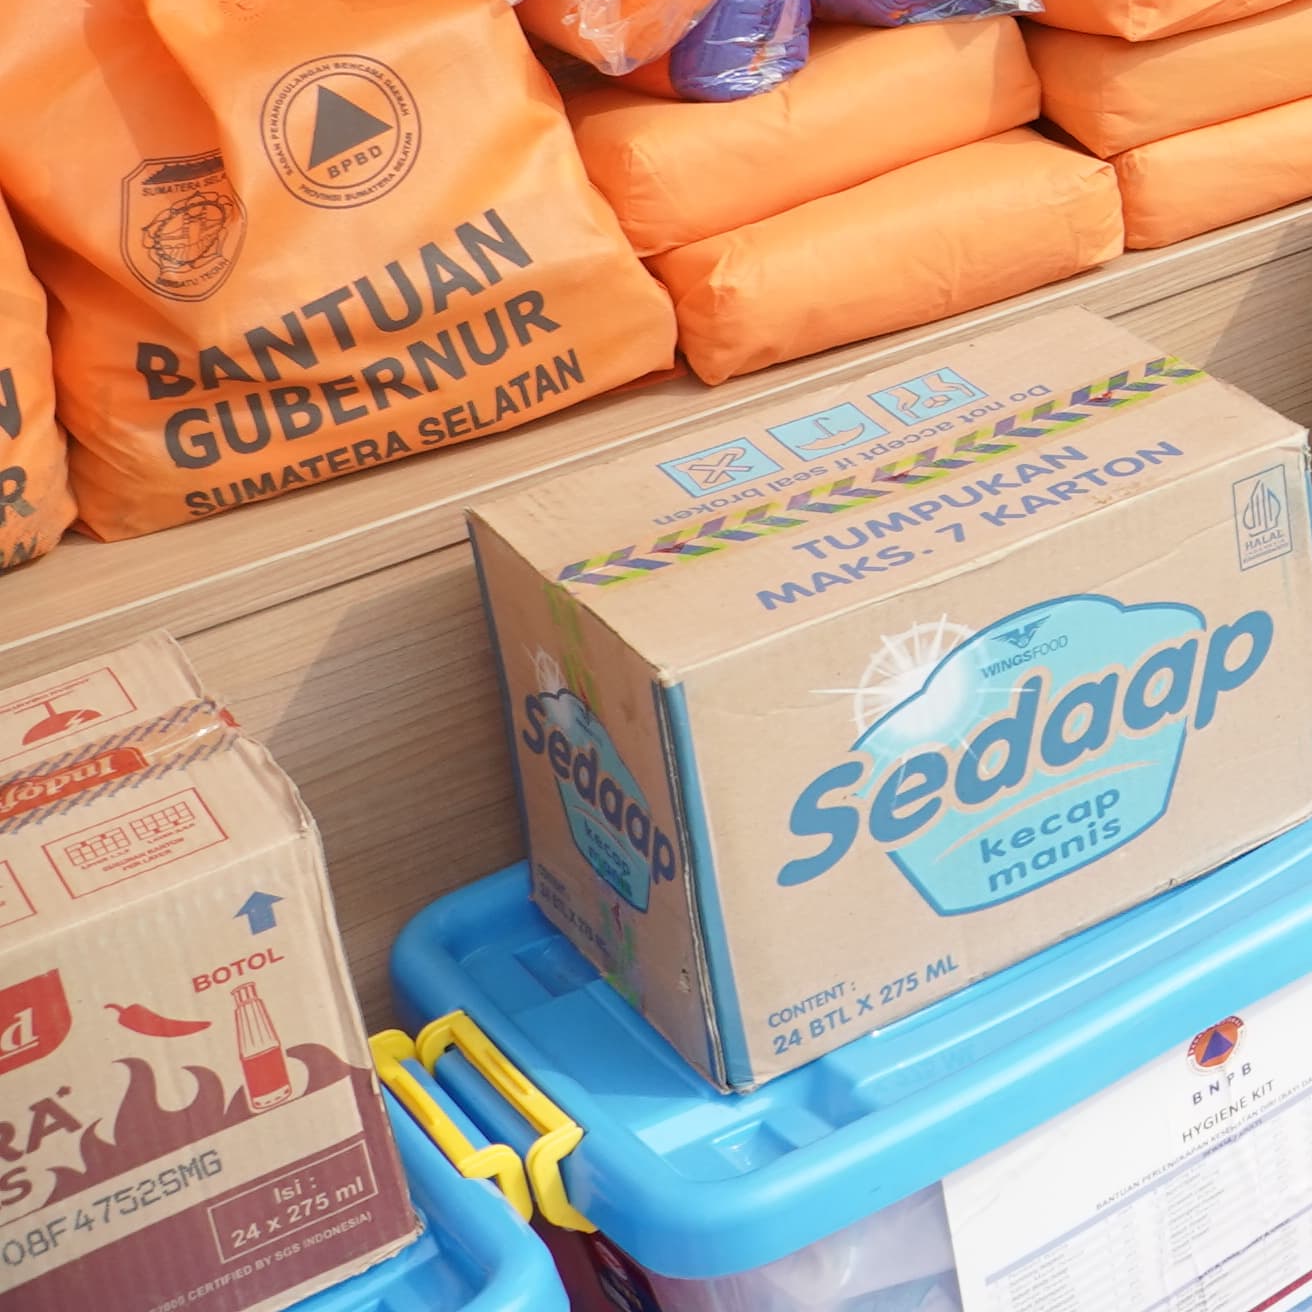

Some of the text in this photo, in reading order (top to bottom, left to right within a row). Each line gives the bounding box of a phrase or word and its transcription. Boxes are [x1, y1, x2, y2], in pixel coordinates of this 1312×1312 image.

[327, 144, 383, 179] BPBD
[135, 208, 534, 401] BANTUAN
[163, 289, 562, 471] GUBERNUR
[184, 348, 586, 517] SUMATERA SELATAN
[652, 383, 1053, 527] Do not accept if seal broken
[755, 439, 1186, 611] MAKS. 7 KARTON
[791, 445, 1089, 561] TUMPUKAN
[1245, 529, 1284, 551] HALAL
[980, 634, 1069, 680] WINGSFOOD
[776, 610, 1274, 888] Sedaap
[522, 693, 676, 886] Sedaap
[979, 787, 1121, 864] kecap
[988, 817, 1123, 892] manis
[191, 947, 285, 995] BOTOL
[767, 981, 846, 1029] CONTENT
[773, 954, 960, 1056] 24 BTL X 275 ML
[1180, 1096, 1248, 1144] HYGIENE
[1250, 1079, 1276, 1103] KIT
[230, 1175, 364, 1249] 24 x 275 ml
[272, 1179, 303, 1205] Isi
[187, 1265, 253, 1301] CERTIFIED
[254, 1256, 274, 1272] BY
[274, 1242, 302, 1263] SGS
